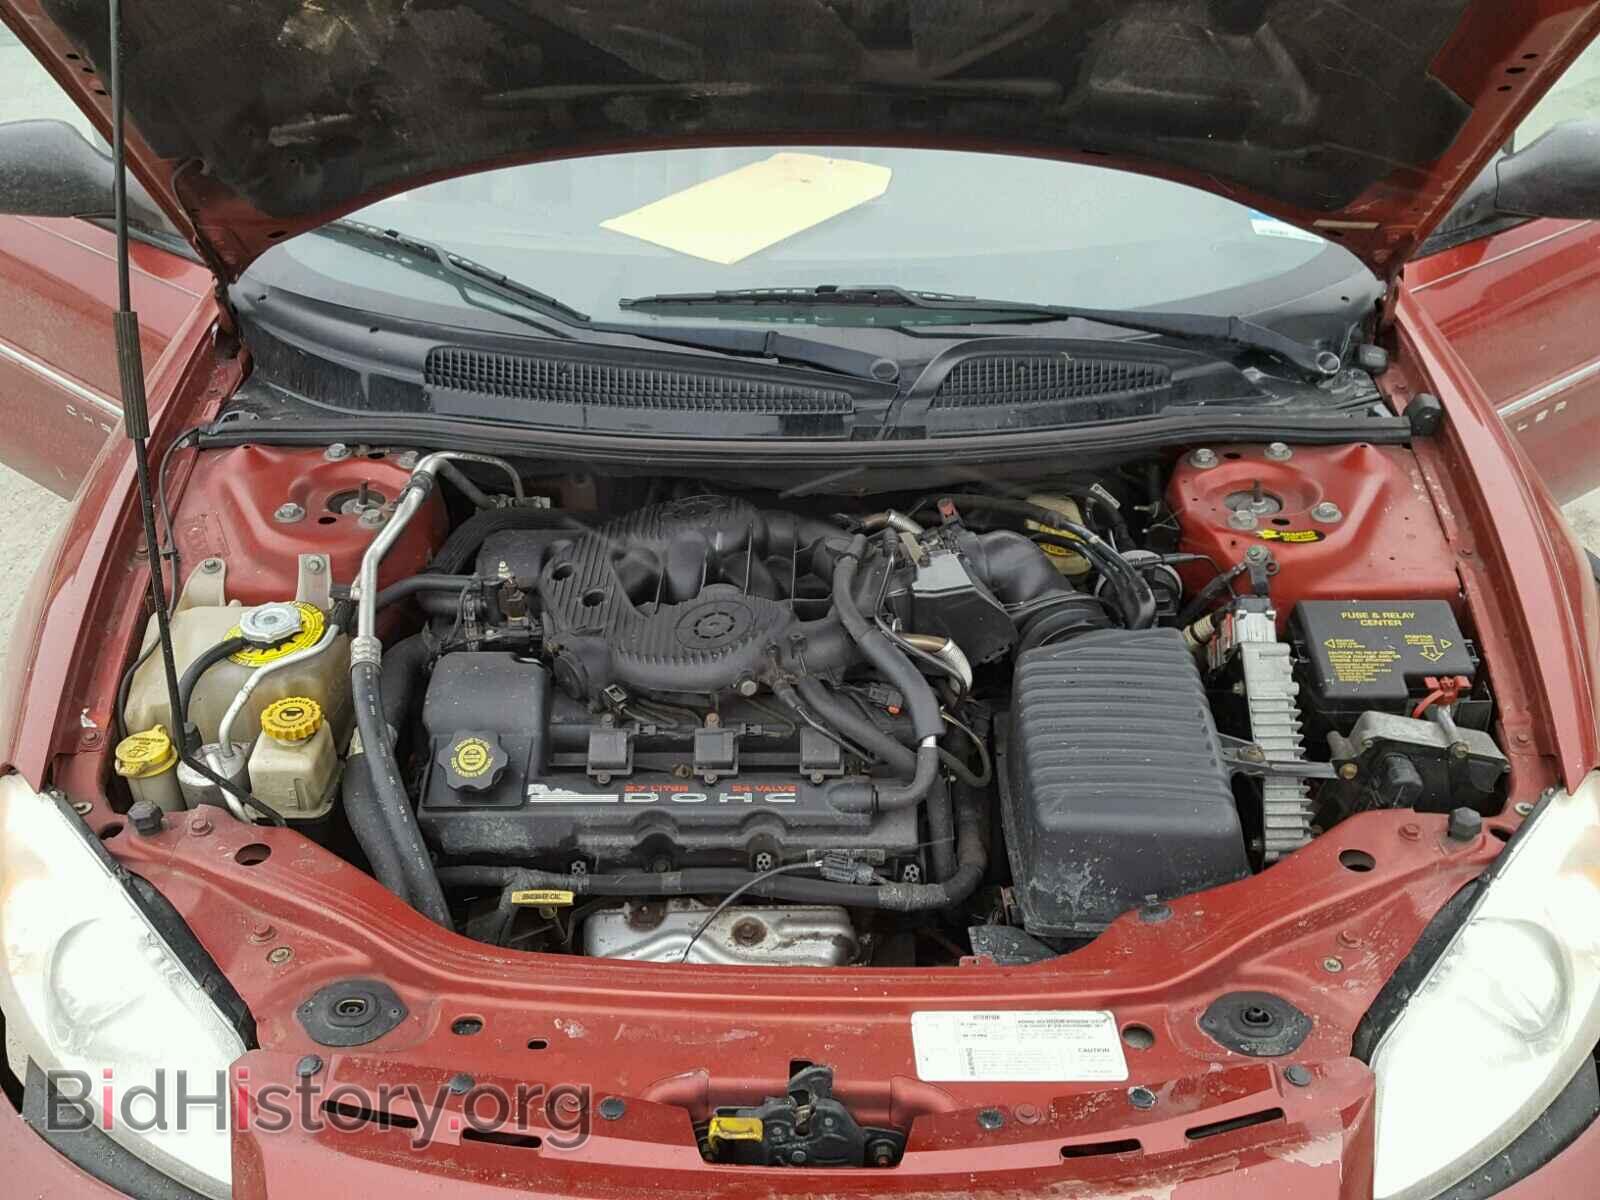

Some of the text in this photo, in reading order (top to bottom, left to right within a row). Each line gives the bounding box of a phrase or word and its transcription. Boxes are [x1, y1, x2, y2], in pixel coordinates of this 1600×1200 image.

[1341, 611, 1369, 619] FUSE
[1382, 611, 1415, 619] RELAY
[625, 784, 646, 792] 2.7
[650, 784, 689, 792] LITER
[755, 784, 797, 792] VALVE
[624, 793, 796, 803] DOHC
